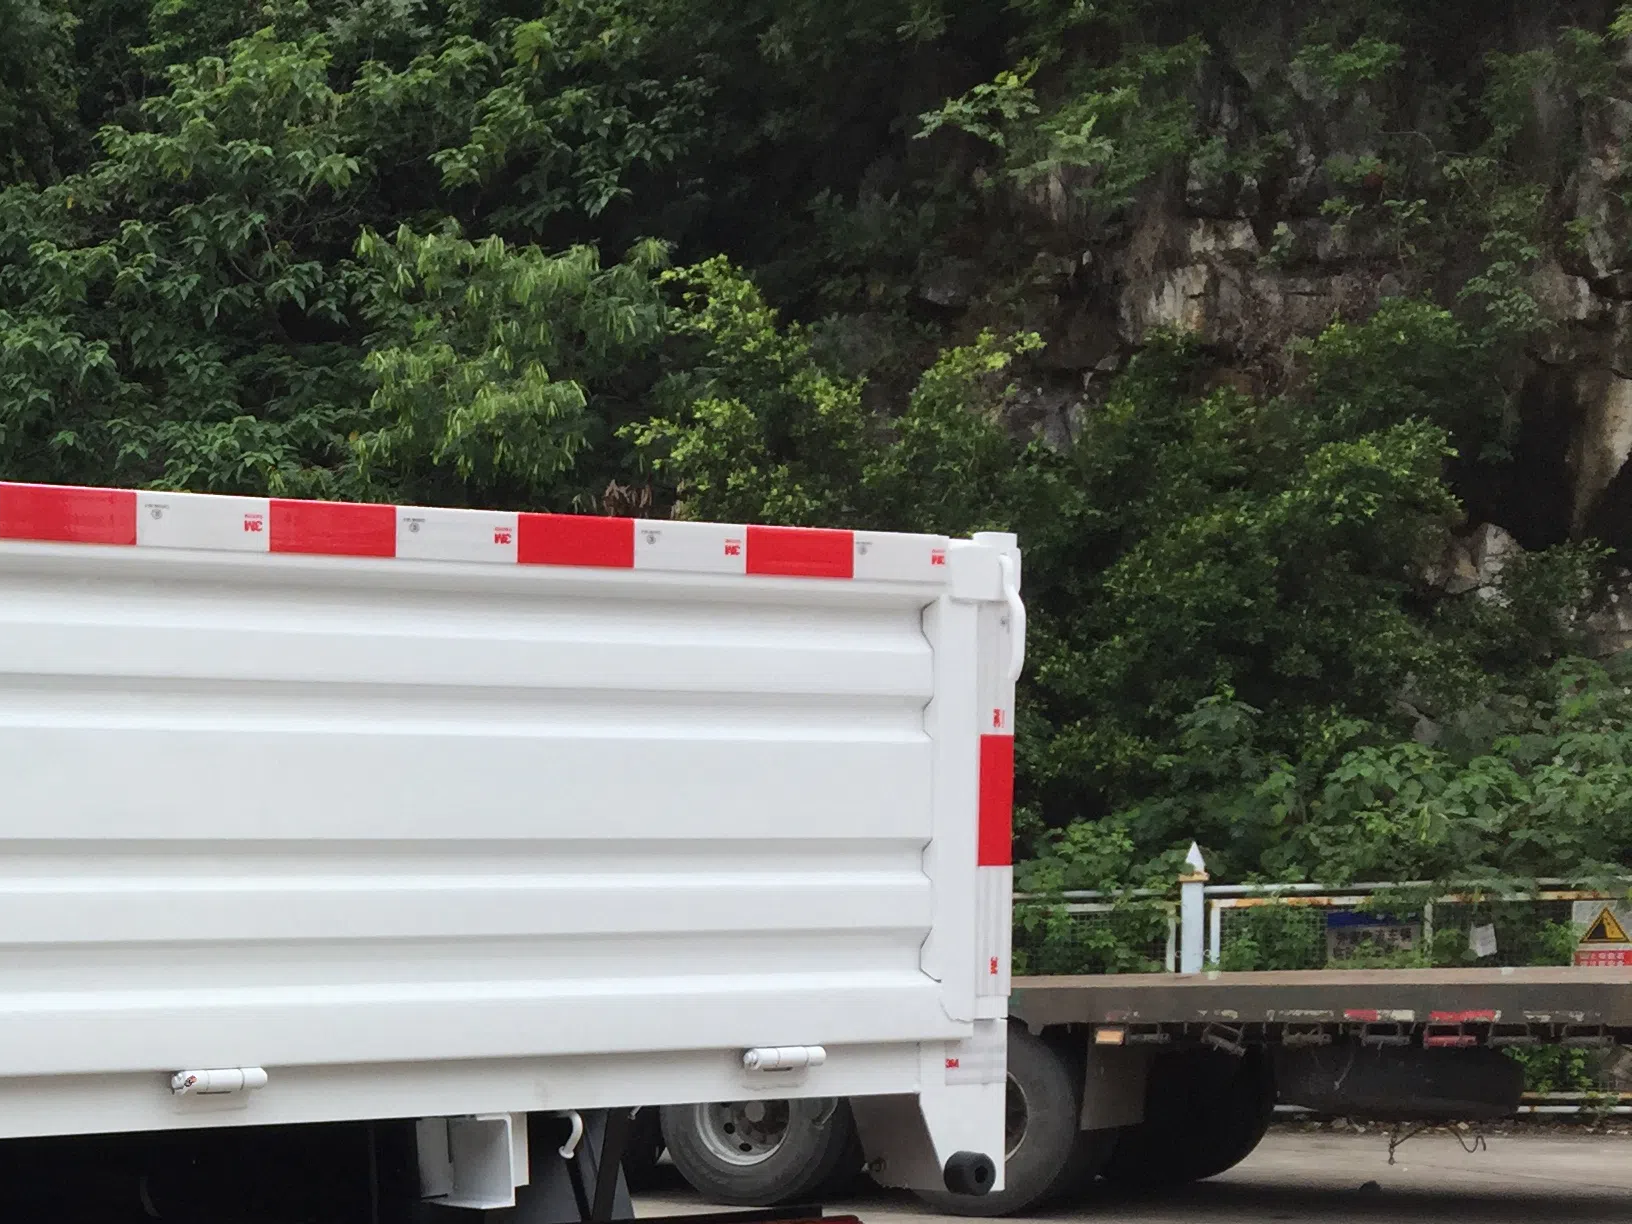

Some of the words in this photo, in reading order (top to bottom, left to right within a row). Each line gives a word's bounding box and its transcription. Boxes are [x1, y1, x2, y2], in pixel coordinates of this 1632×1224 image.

[243, 519, 262, 533] 3M
[494, 533, 511, 544] 3M
[725, 545, 740, 556] 3M
